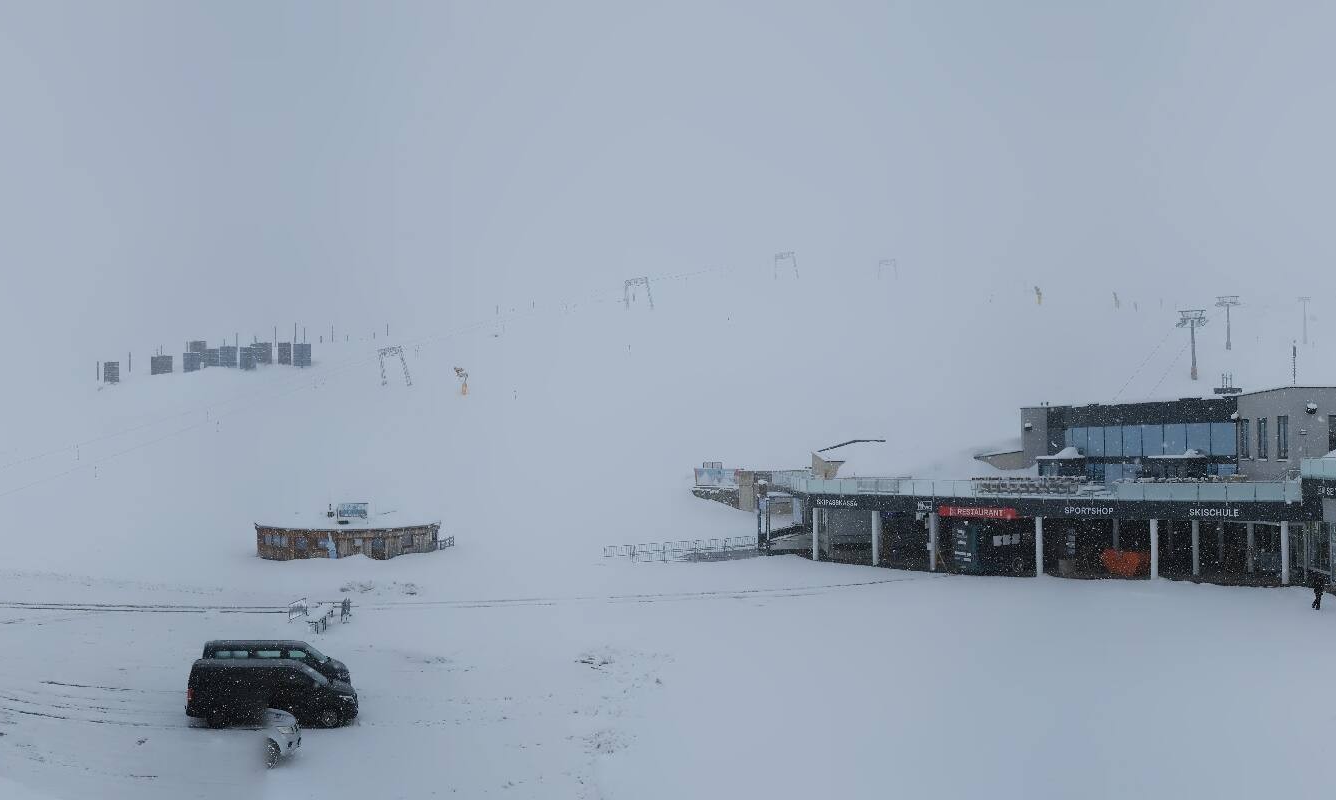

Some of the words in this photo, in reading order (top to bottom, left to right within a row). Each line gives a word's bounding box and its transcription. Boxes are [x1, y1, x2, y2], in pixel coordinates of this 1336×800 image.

[957, 508, 1003, 516] RESTAURANT
[1064, 506, 1113, 515] SPORTSHOP
[1189, 508, 1239, 517] SKISCHULE
